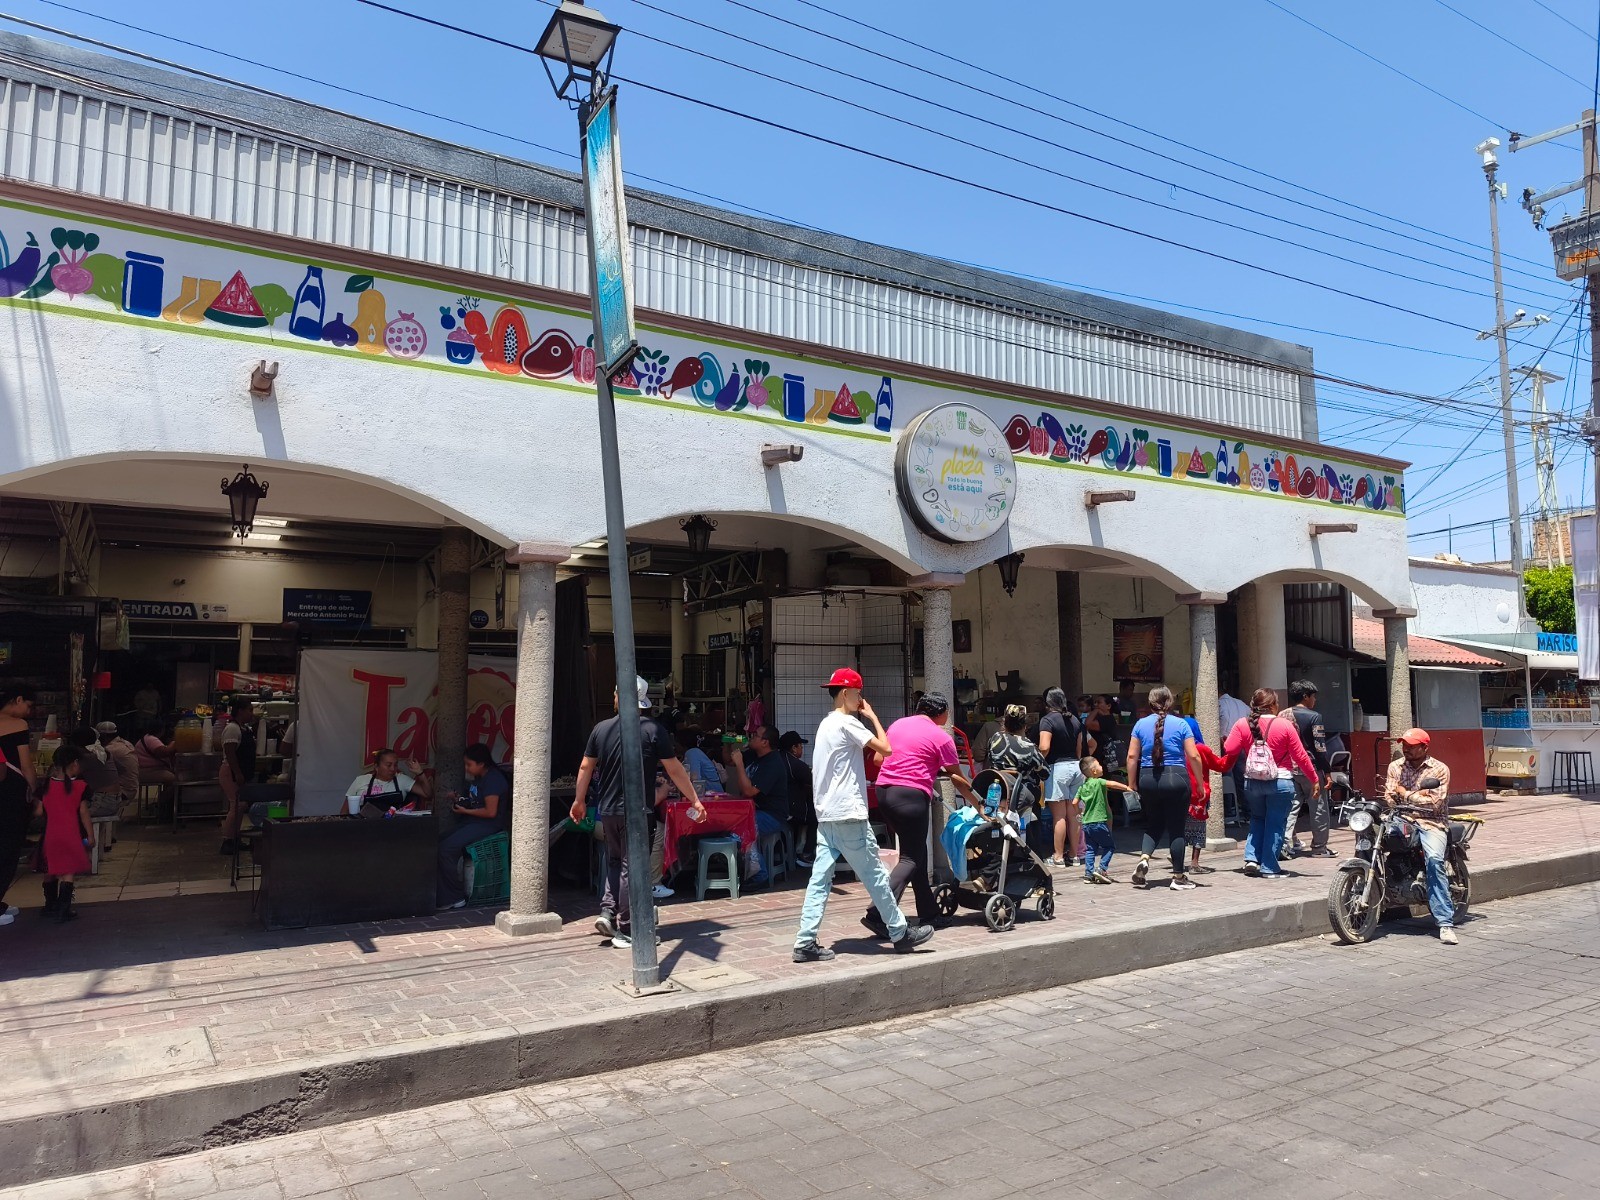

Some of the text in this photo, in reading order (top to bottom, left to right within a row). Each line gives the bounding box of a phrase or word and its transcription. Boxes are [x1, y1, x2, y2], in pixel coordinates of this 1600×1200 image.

[941, 447, 985, 485] plaza
[948, 483, 983, 495] está aquí
[123, 604, 192, 616] ENTRADA
[710, 635, 730, 647] SALIDA
[1488, 761, 1514, 769] pepsi
